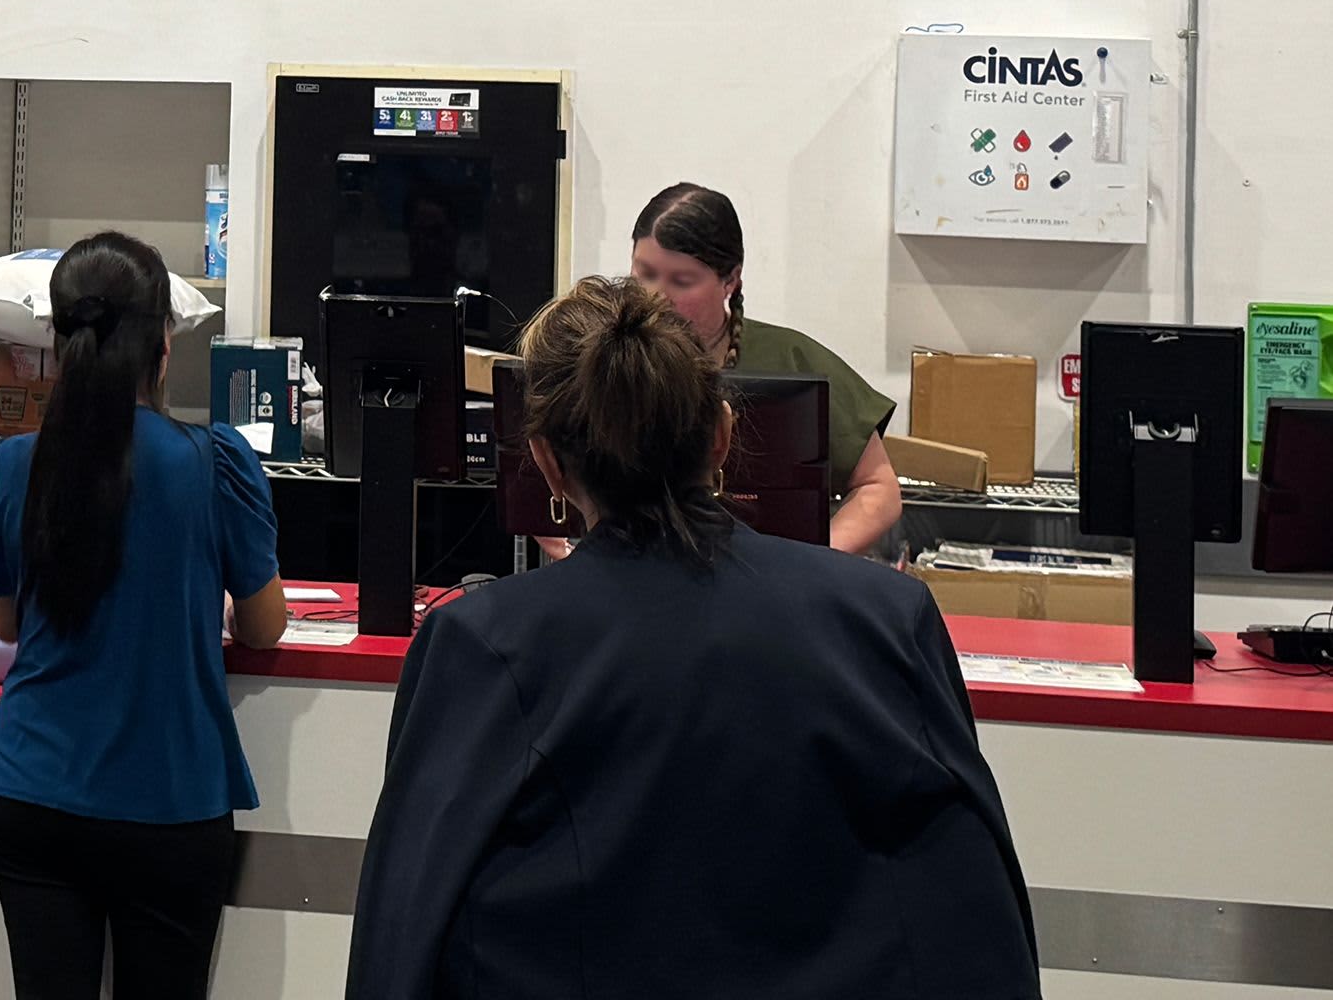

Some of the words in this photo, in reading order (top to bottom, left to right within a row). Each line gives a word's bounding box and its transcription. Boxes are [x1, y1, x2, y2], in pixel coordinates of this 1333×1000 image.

[964, 89, 997, 103] First
[1002, 91, 1028, 104] Aid
[1033, 91, 1086, 107] Center
[1256, 321, 1315, 338] eyesaline
